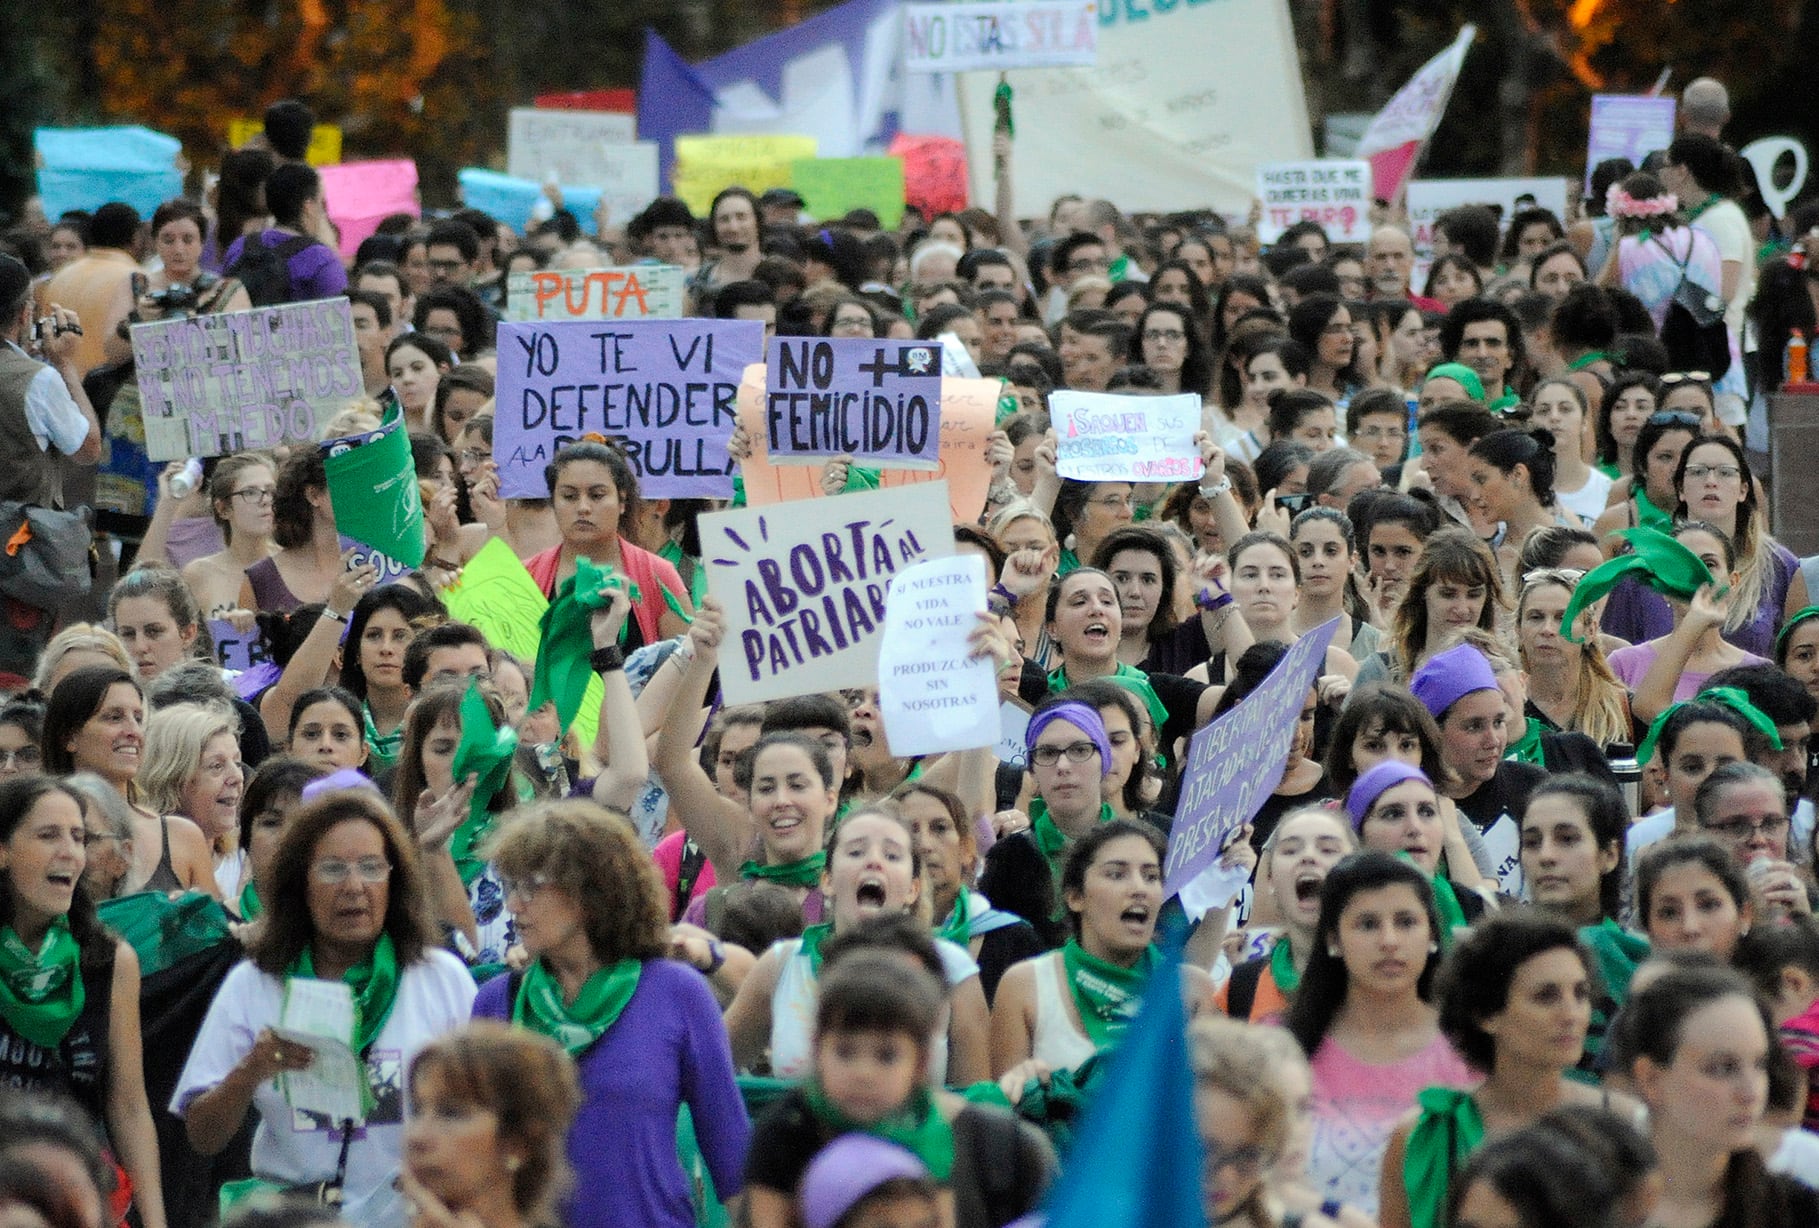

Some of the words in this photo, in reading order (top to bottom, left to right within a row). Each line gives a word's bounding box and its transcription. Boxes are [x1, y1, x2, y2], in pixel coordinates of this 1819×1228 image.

[909, 16, 945, 58] NO
[531, 272, 649, 318] PUTA
[134, 314, 219, 370] SOMOS
[226, 306, 334, 361] MUCHAS
[335, 300, 354, 346] Y
[517, 332, 559, 378] YO
[590, 332, 637, 374] TE
[669, 333, 714, 374] VI
[171, 366, 207, 410] NO
[210, 351, 360, 402] TENEMOS
[779, 341, 834, 390] NO
[523, 382, 738, 431] DEFENDER
[745, 519, 895, 627] ABORTÁ
[899, 529, 926, 563] AL
[911, 574, 972, 590] NUESTRA
[904, 619, 924, 630] NO
[927, 615, 963, 628] VALE
[916, 598, 949, 611] VIDA
[893, 658, 980, 677] PRODUZCAN
[926, 680, 949, 691] SIN
[902, 693, 978, 712] NOSOTRAS
[1165, 804, 1221, 878] PRESA
